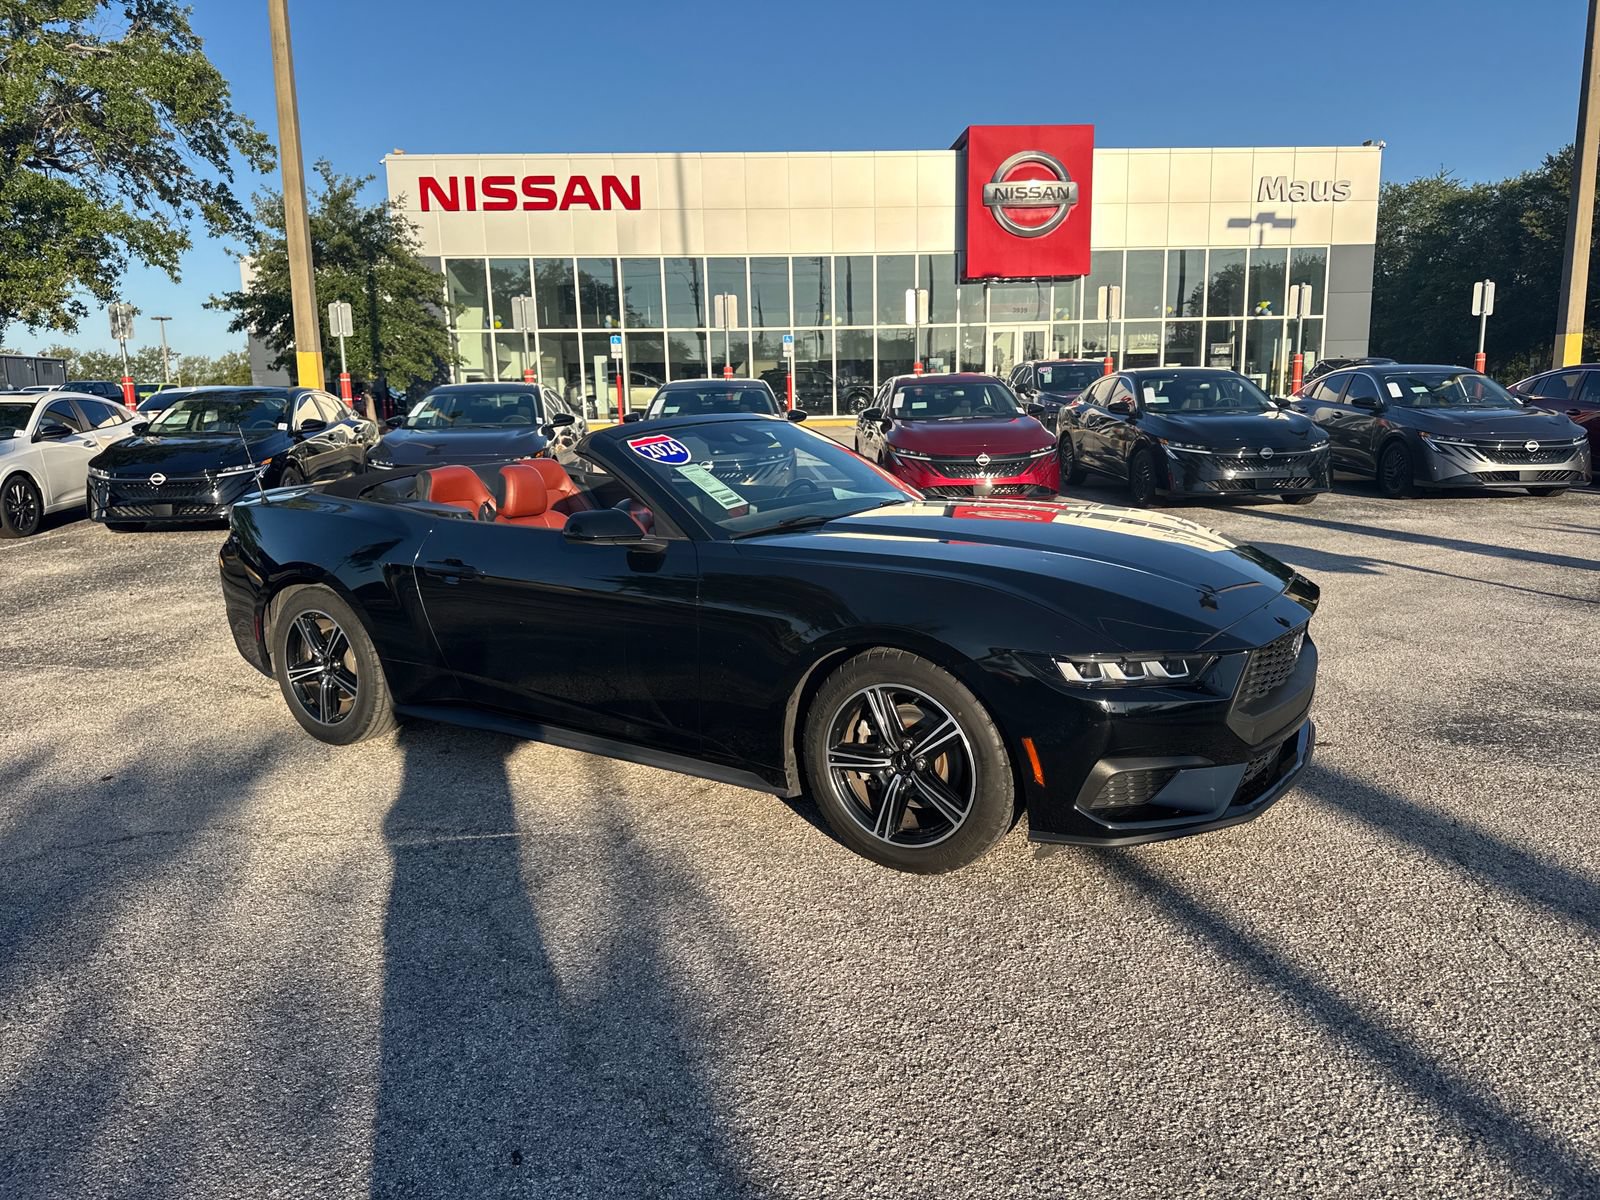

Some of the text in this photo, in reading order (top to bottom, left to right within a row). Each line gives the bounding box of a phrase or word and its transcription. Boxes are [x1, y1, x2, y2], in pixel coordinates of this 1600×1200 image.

[418, 175, 642, 212] NISSAN
[993, 186, 1070, 201] NISSAN
[1257, 175, 1352, 202] Maus
[641, 442, 685, 458] 2024
